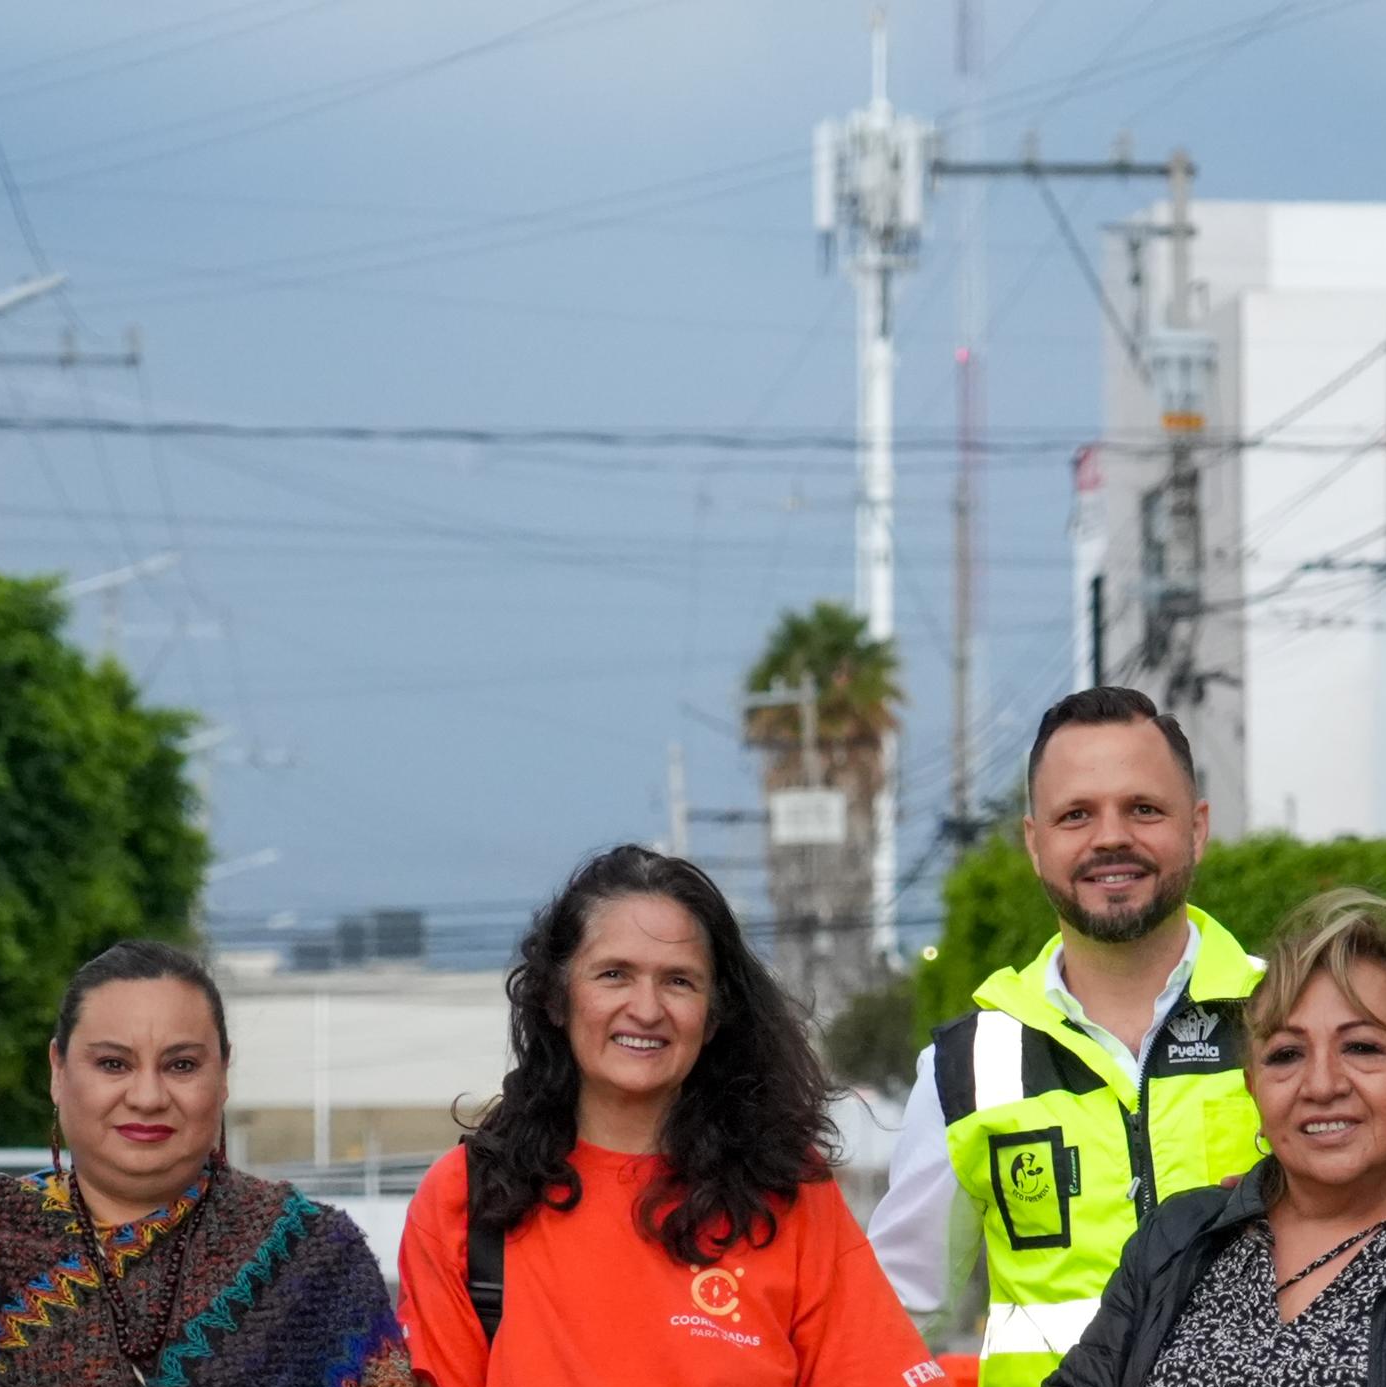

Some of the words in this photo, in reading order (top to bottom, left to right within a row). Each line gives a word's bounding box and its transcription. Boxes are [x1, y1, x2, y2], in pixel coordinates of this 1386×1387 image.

[1168, 1042, 1220, 1058] Puebla
[1013, 1188, 1024, 1201] ECO
[1025, 1183, 1050, 1203] FRIENDLY
